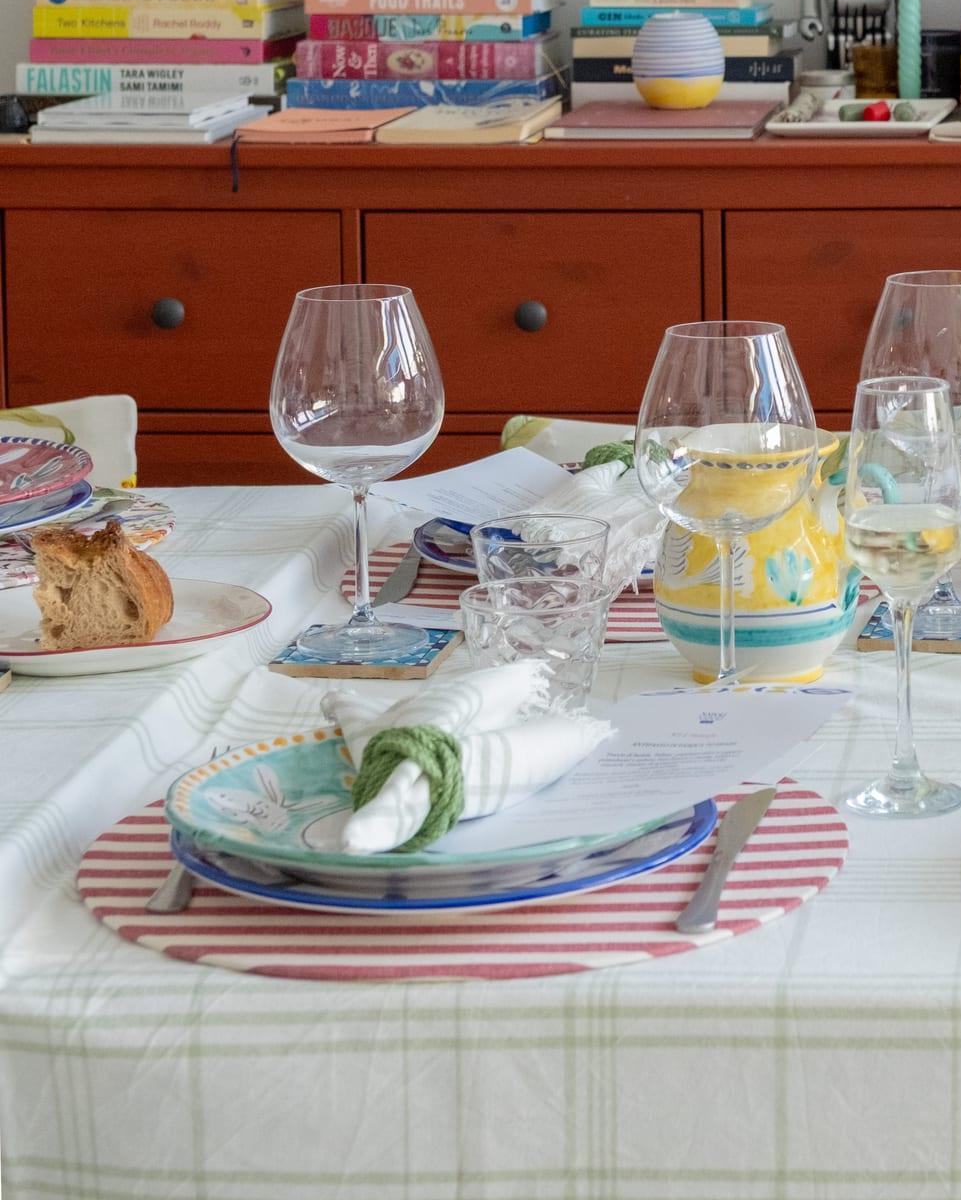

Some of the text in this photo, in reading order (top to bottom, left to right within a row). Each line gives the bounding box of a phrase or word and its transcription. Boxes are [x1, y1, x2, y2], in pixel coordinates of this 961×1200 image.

[598, 12, 622, 21] GIN
[58, 17, 126, 29] Two Kitchens
[153, 17, 186, 29] Rachel
[333, 43, 346, 78] Now
[348, 53, 362, 72] &
[120, 69, 184, 79] TARA WIGLEY
[27, 68, 112, 93] FALASTIN
[120, 82, 184, 92] SAMI TAMIMI
